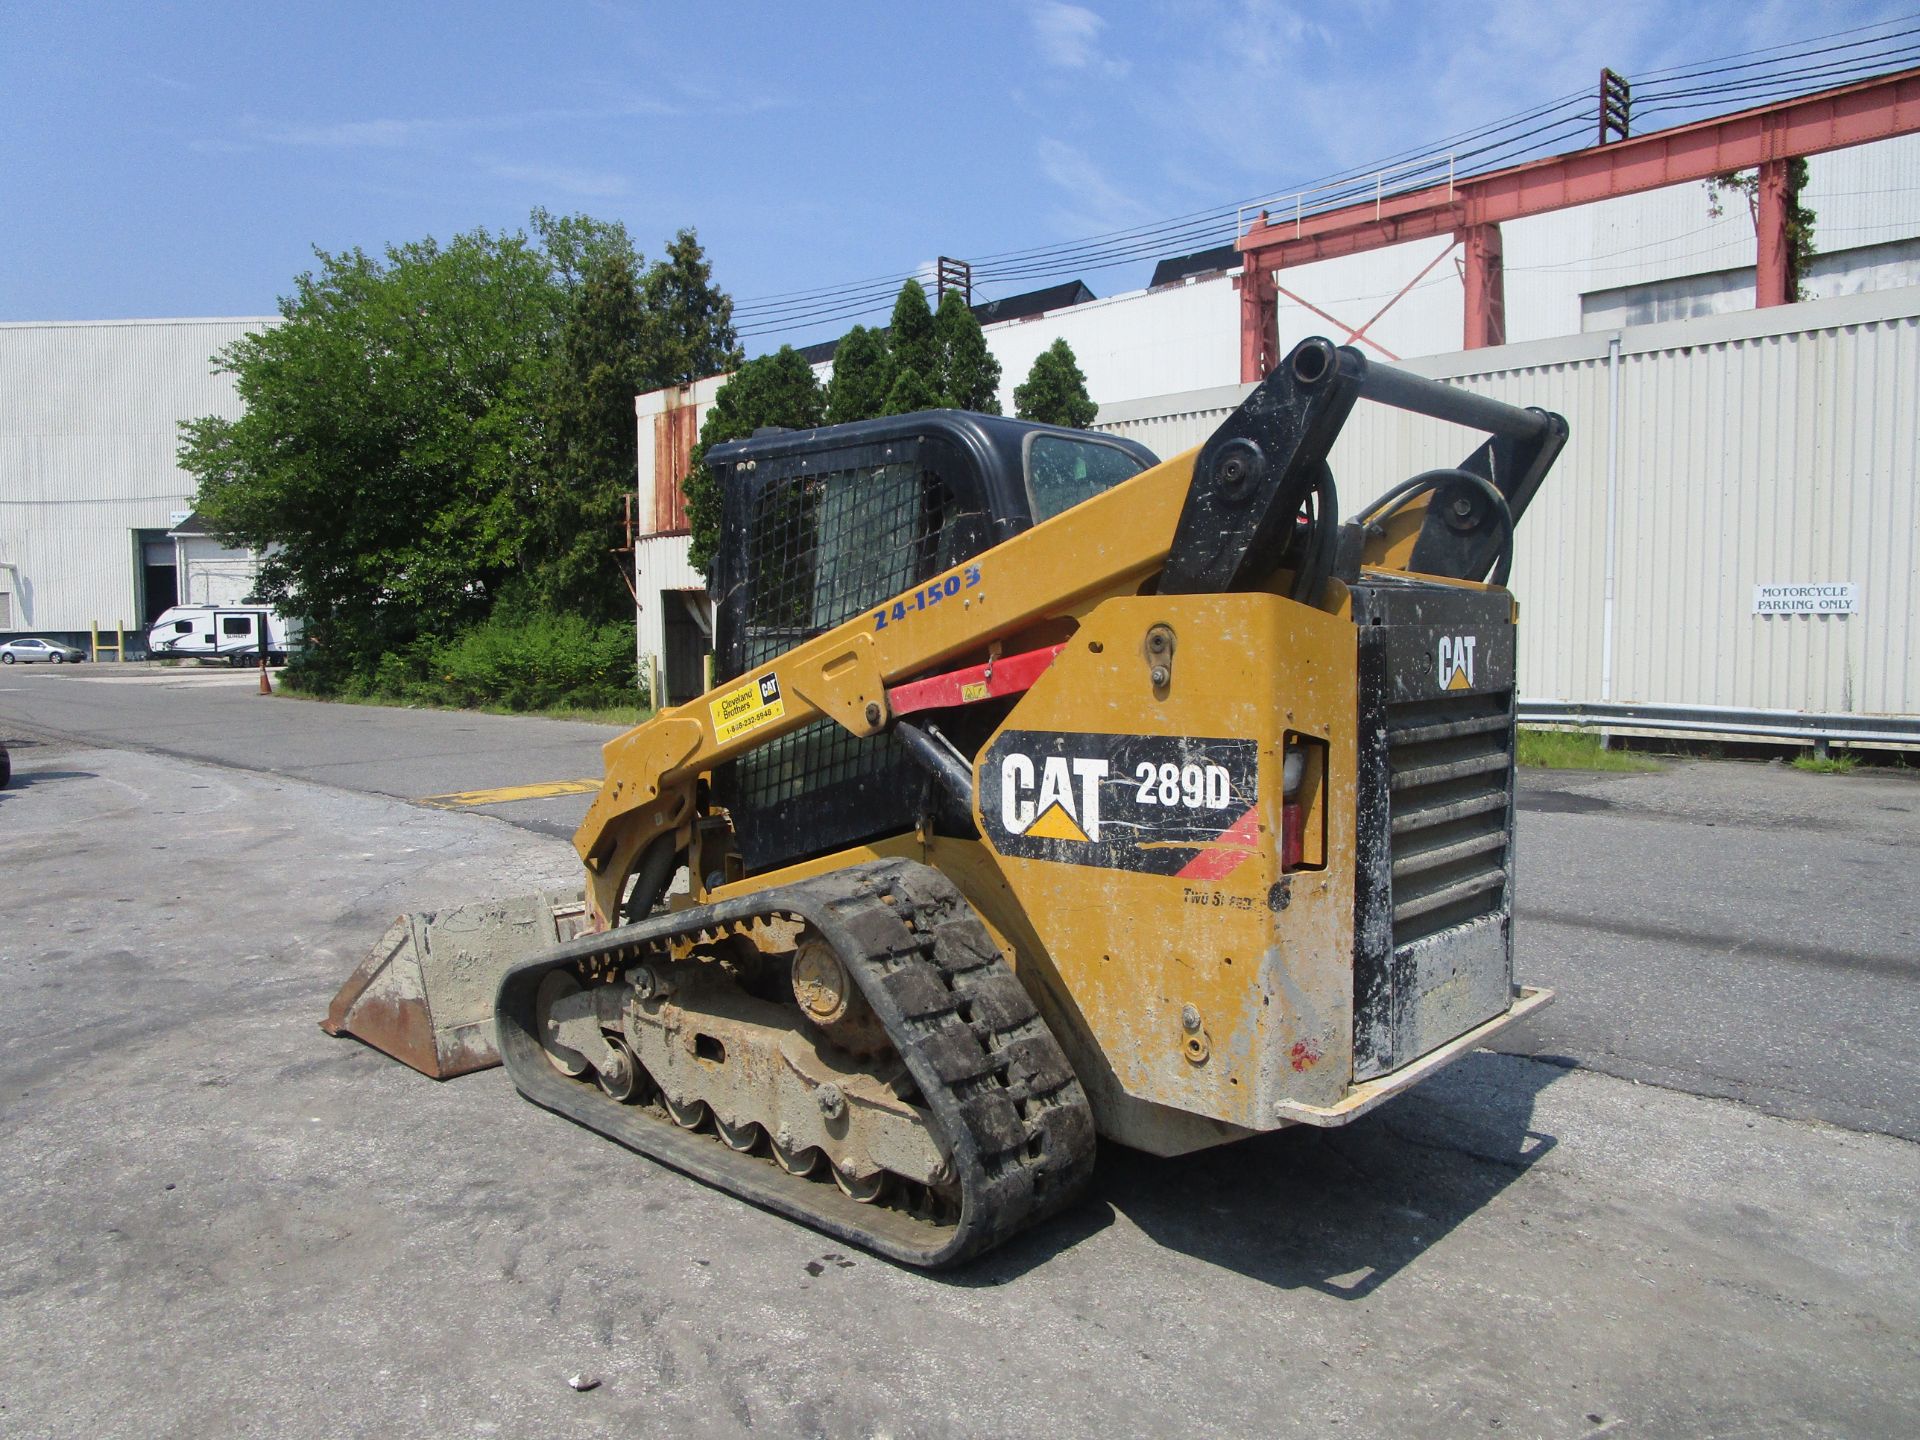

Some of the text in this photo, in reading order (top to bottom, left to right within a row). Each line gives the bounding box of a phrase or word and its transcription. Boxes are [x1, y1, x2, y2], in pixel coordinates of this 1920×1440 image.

[873, 567, 981, 632] 24-1503
[1762, 587, 1849, 598] MOTORCYCLE
[1758, 600, 1853, 610] PARKING ONLY
[1438, 636, 1476, 691] CAT
[761, 679, 777, 698] CAT
[721, 689, 753, 710] Cleveland
[724, 701, 751, 720] Brothers
[1001, 753, 1230, 843] CAT 289D
